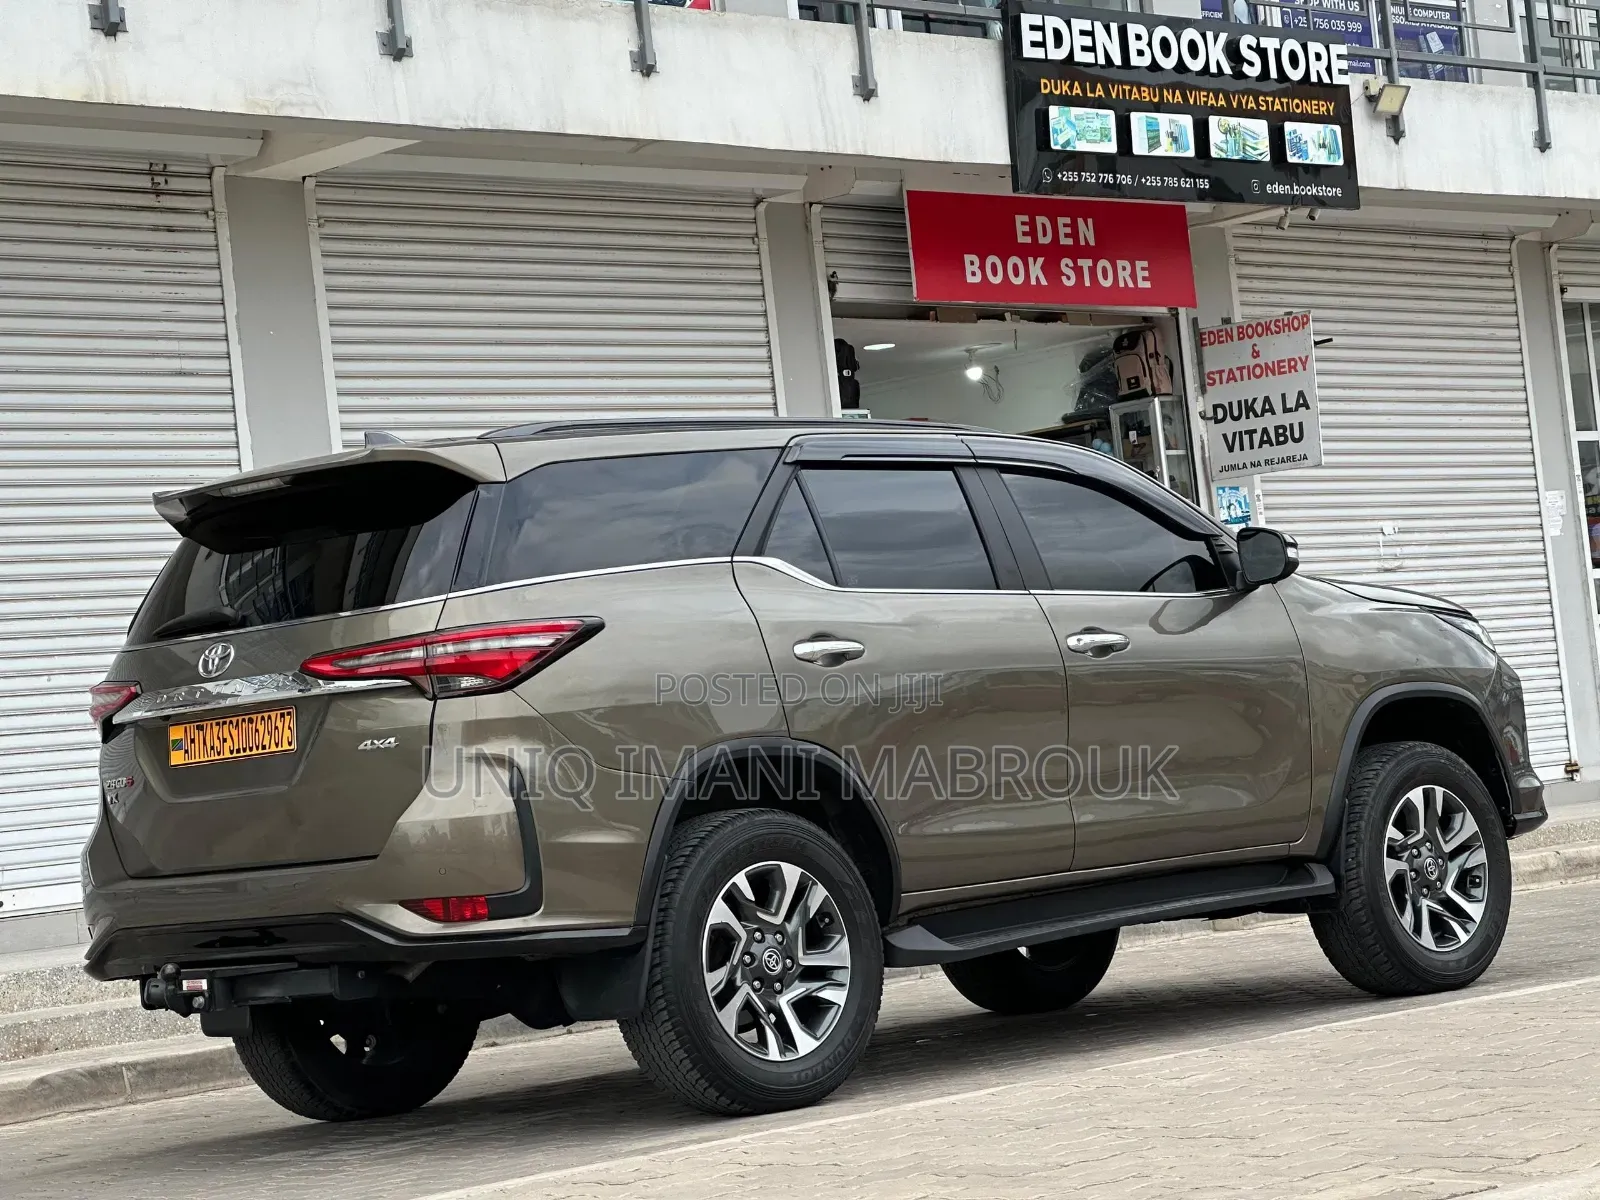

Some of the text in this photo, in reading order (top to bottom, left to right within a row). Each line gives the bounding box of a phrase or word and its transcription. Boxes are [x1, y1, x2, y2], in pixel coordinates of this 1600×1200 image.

[1322, 0, 1346, 10] WITH
[1348, 1, 1360, 12] US
[1413, 8, 1451, 20] COMPUTER
[1314, 18, 1330, 29] 756
[1330, 20, 1346, 31] 035
[1347, 21, 1362, 33] 999
[1020, 13, 1350, 85] EDEN BOOK STORE
[1040, 78, 1335, 116] DUKA LA VITABU NA VIFAA VYA STATIONERY
[1057, 171, 1079, 182] +255
[1080, 172, 1097, 183] 752
[1098, 173, 1115, 184] 776
[1116, 174, 1133, 185] 706
[1141, 176, 1162, 187] +255
[1163, 176, 1179, 188] 785
[1180, 178, 1195, 188] 621
[1195, 178, 1210, 189] 155
[1266, 181, 1343, 197] eden.bookstore
[1014, 214, 1096, 246] EDEN
[963, 253, 1152, 289] BOOK STORE
[1200, 313, 1310, 348] EDEN BOOKSHOP
[1251, 343, 1261, 360] &
[1206, 354, 1310, 388] STATIONERY
[1212, 389, 1311, 425] DUKA LA
[1222, 421, 1305, 453] VITABU
[1218, 453, 1309, 473] JUMLA NA REJAREJA
[183, 710, 294, 762] AHTKA3FS100629673
